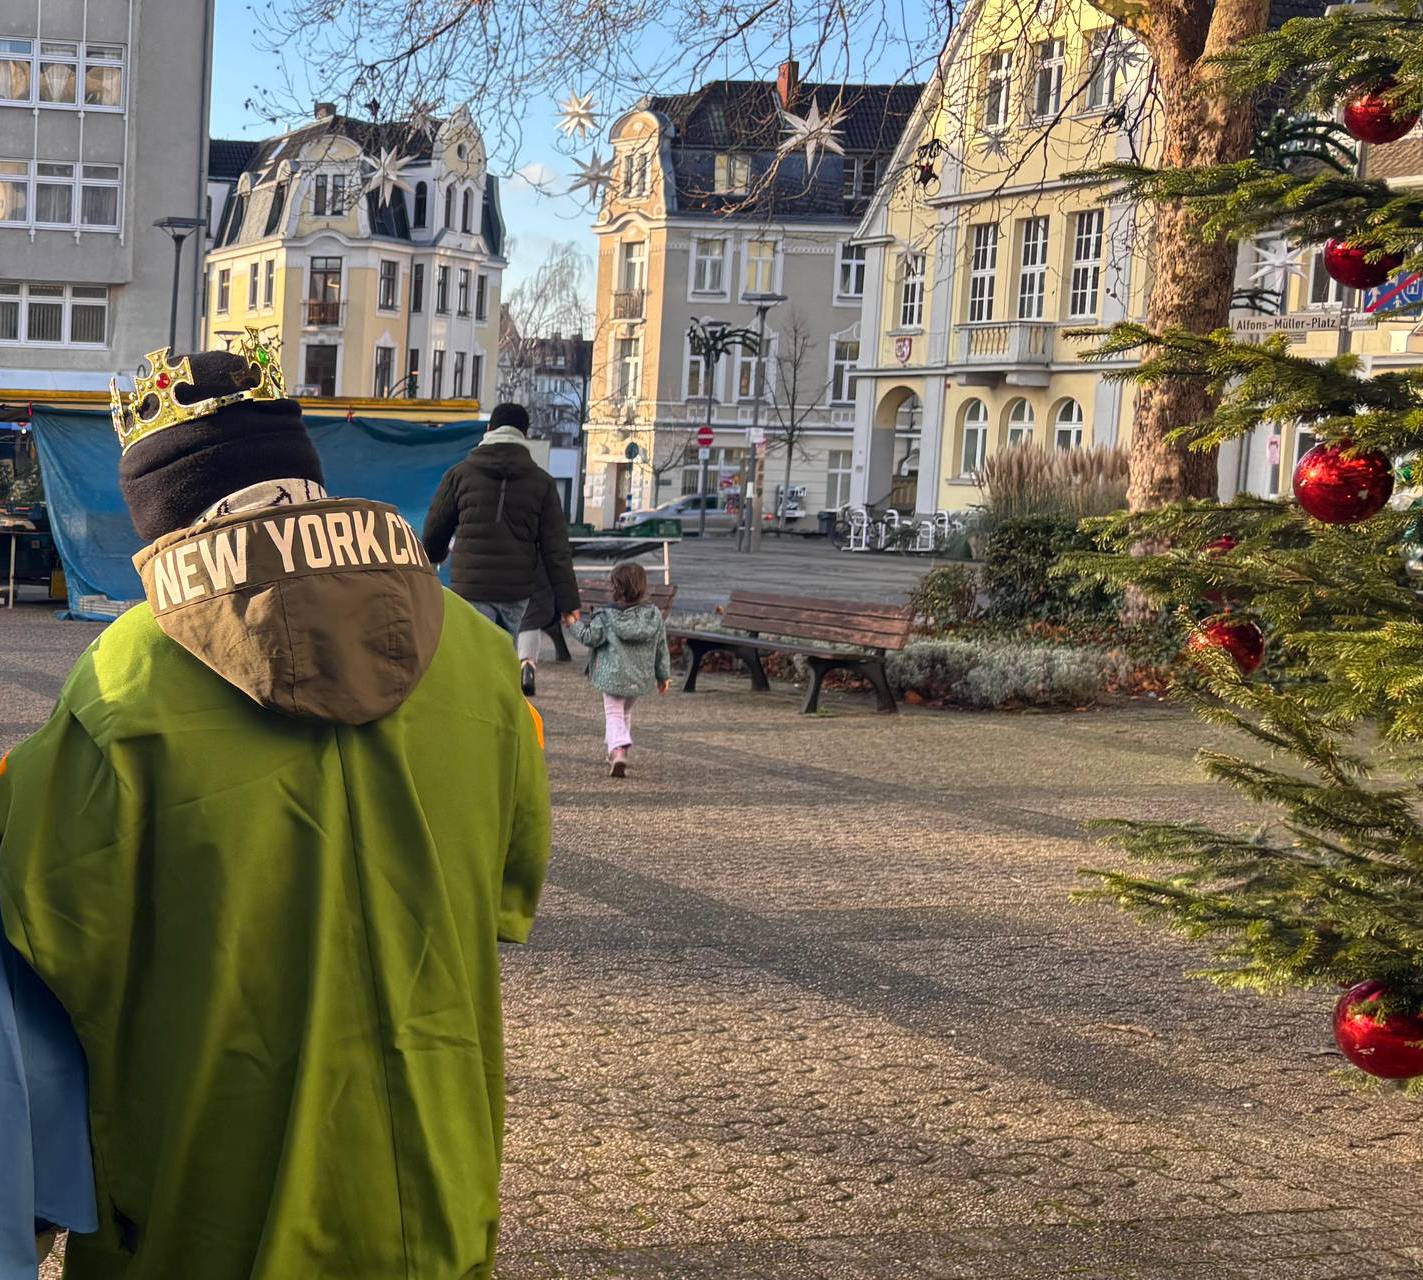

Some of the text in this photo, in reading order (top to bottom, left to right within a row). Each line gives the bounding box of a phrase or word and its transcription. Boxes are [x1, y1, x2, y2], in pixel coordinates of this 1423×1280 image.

[1236, 316, 1337, 331] Alfons-Müller-Platz
[154, 510, 425, 611] NEW YORK CIT
